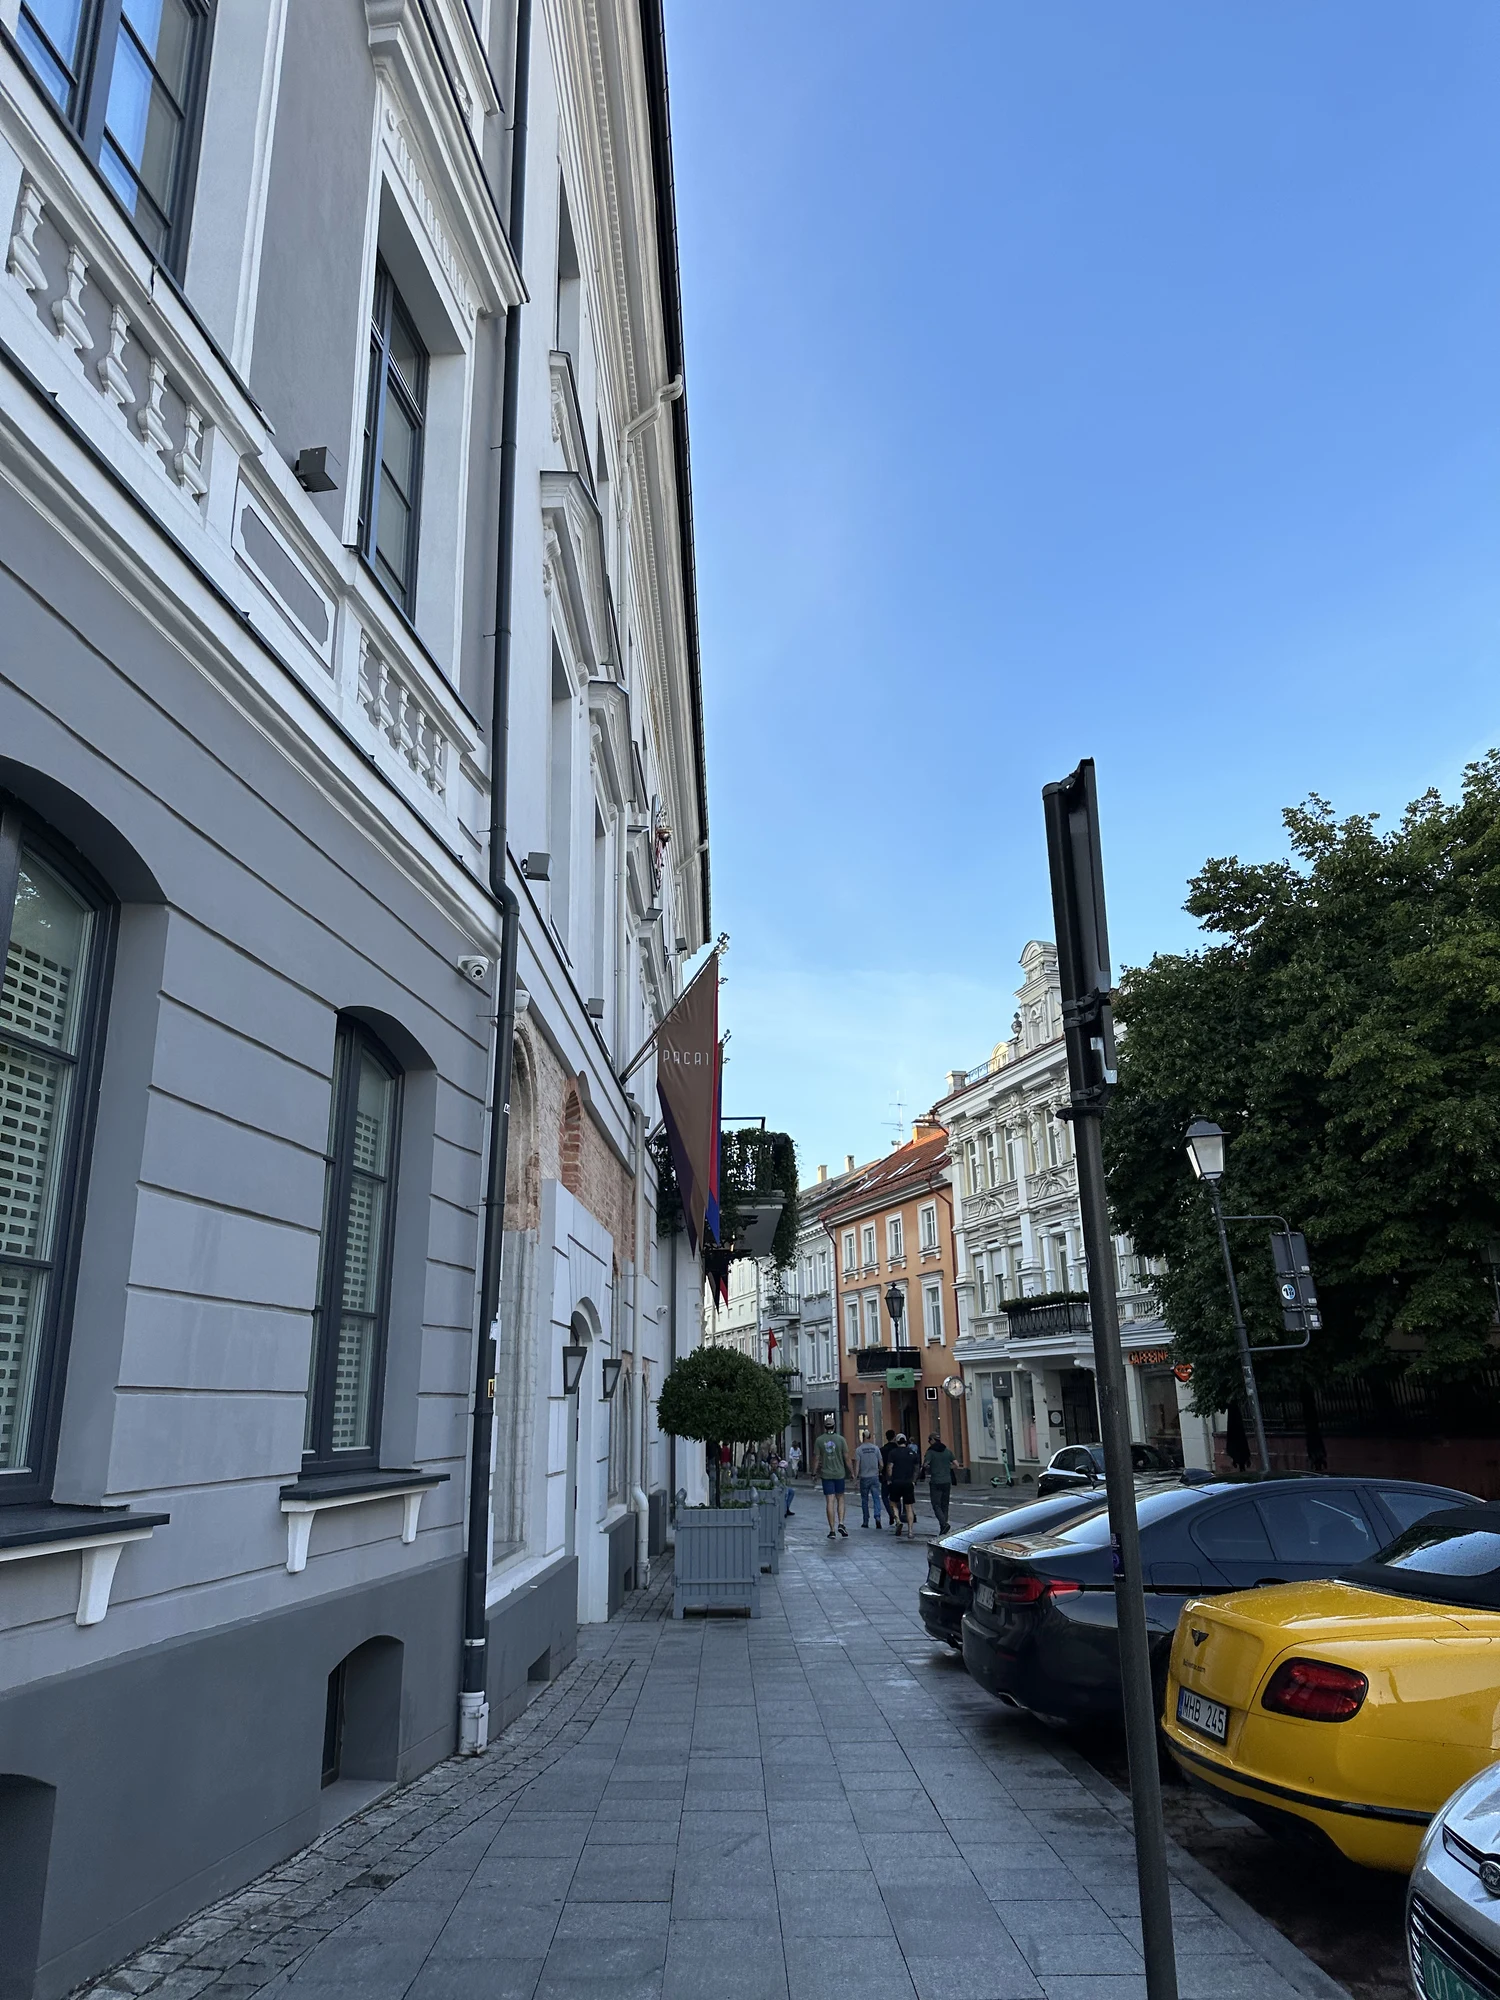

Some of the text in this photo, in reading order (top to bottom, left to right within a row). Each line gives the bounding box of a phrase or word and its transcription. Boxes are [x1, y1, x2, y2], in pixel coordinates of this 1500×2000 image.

[662, 1049, 710, 1066] PACAI
[1182, 1693, 1225, 1734] MHB 245
